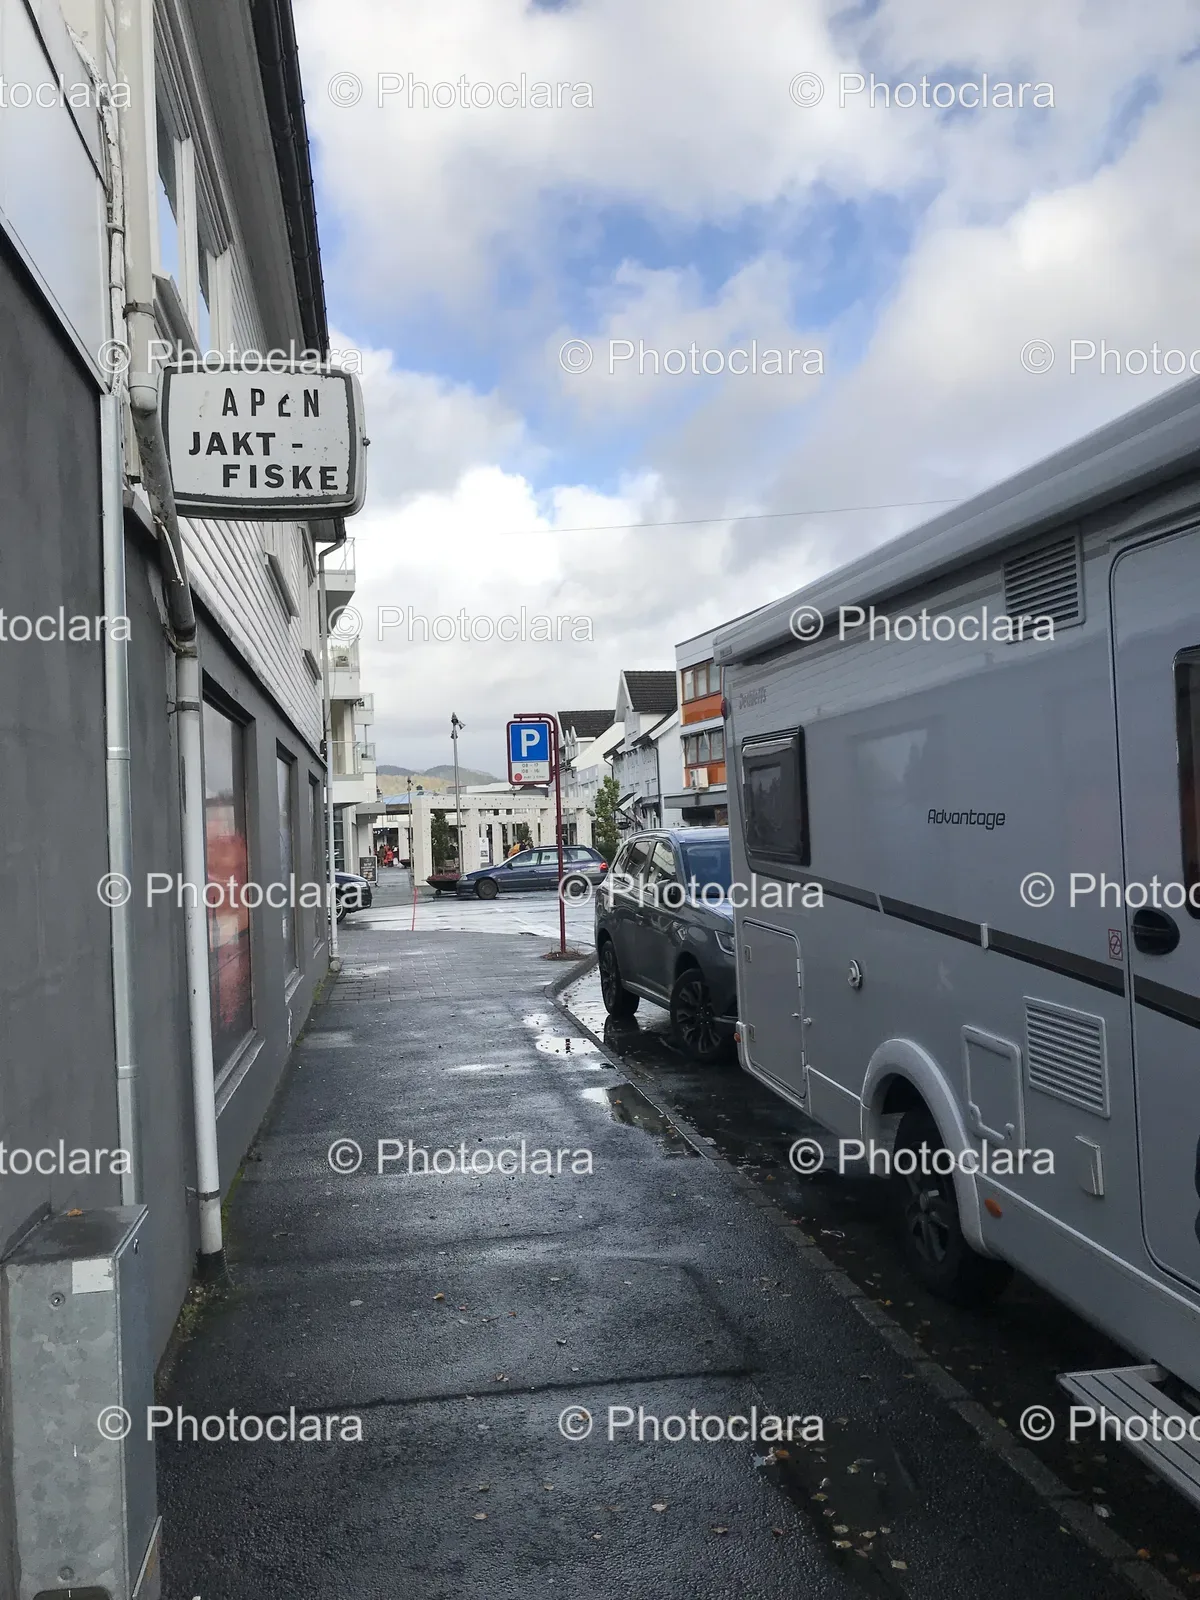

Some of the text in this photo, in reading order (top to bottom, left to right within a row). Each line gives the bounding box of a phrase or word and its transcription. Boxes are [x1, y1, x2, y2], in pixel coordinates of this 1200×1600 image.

[189, 432, 276, 456] JAKT
[222, 464, 338, 490] FISKE
[521, 729, 540, 757] P
[928, 809, 1006, 830] Advantage
